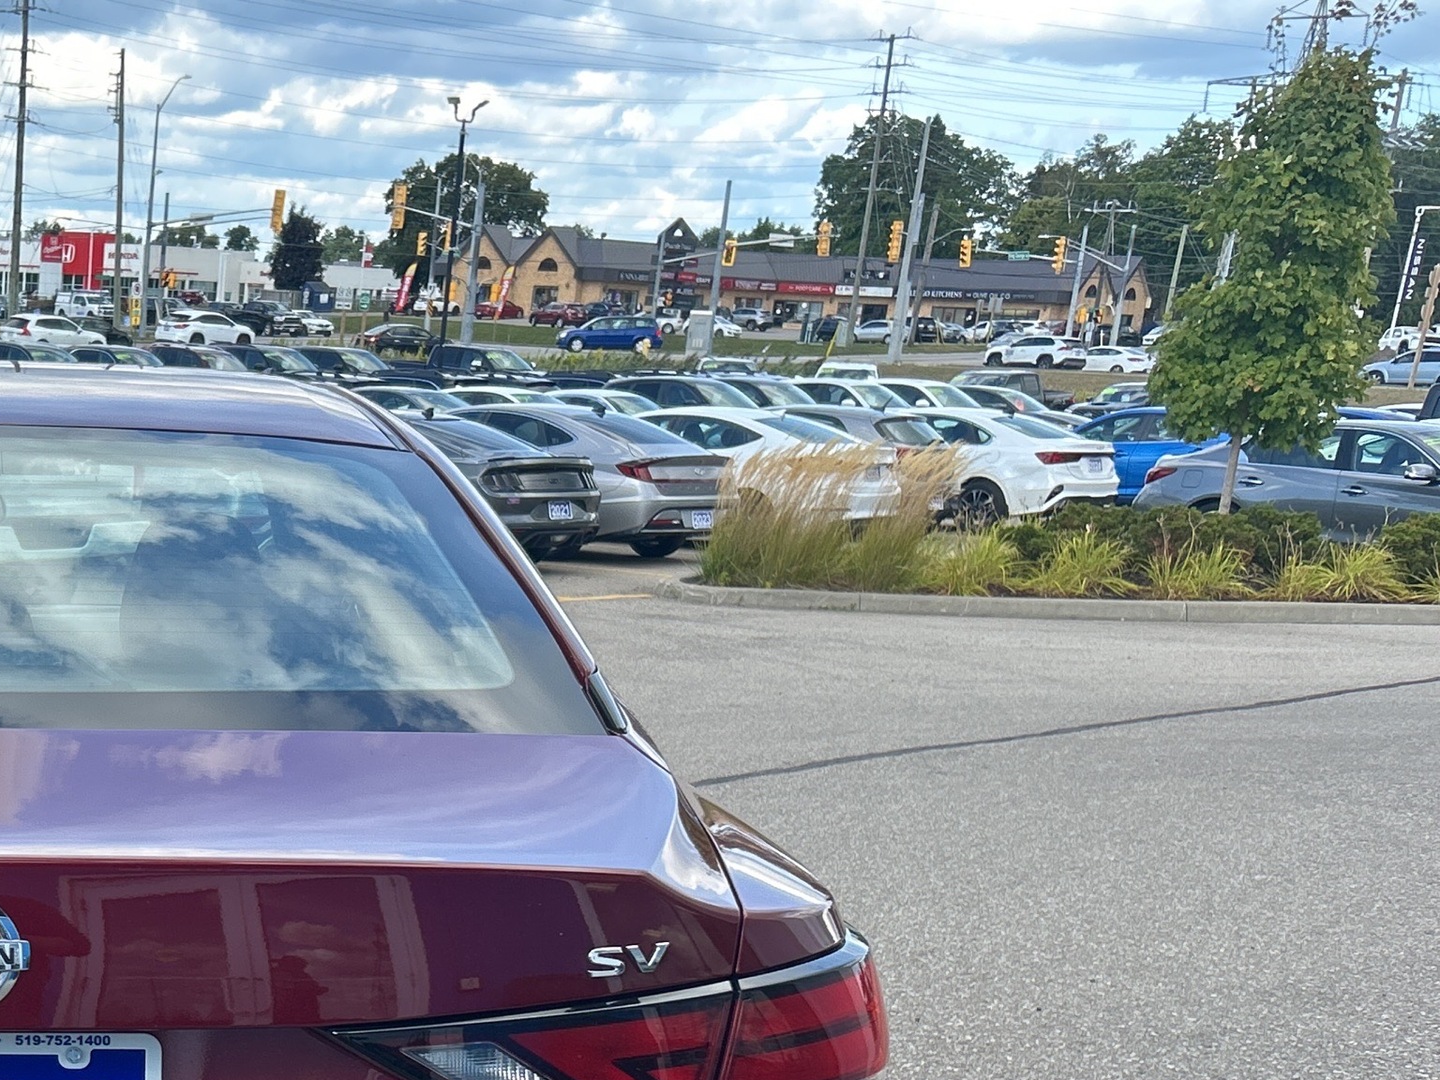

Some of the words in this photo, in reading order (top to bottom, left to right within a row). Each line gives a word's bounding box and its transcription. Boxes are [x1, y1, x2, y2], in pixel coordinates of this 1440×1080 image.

[1405, 239, 1426, 299] NISSAN
[551, 504, 570, 516] 2021
[587, 941, 670, 977] SV
[15, 1035, 111, 1046] 519-752-1400
